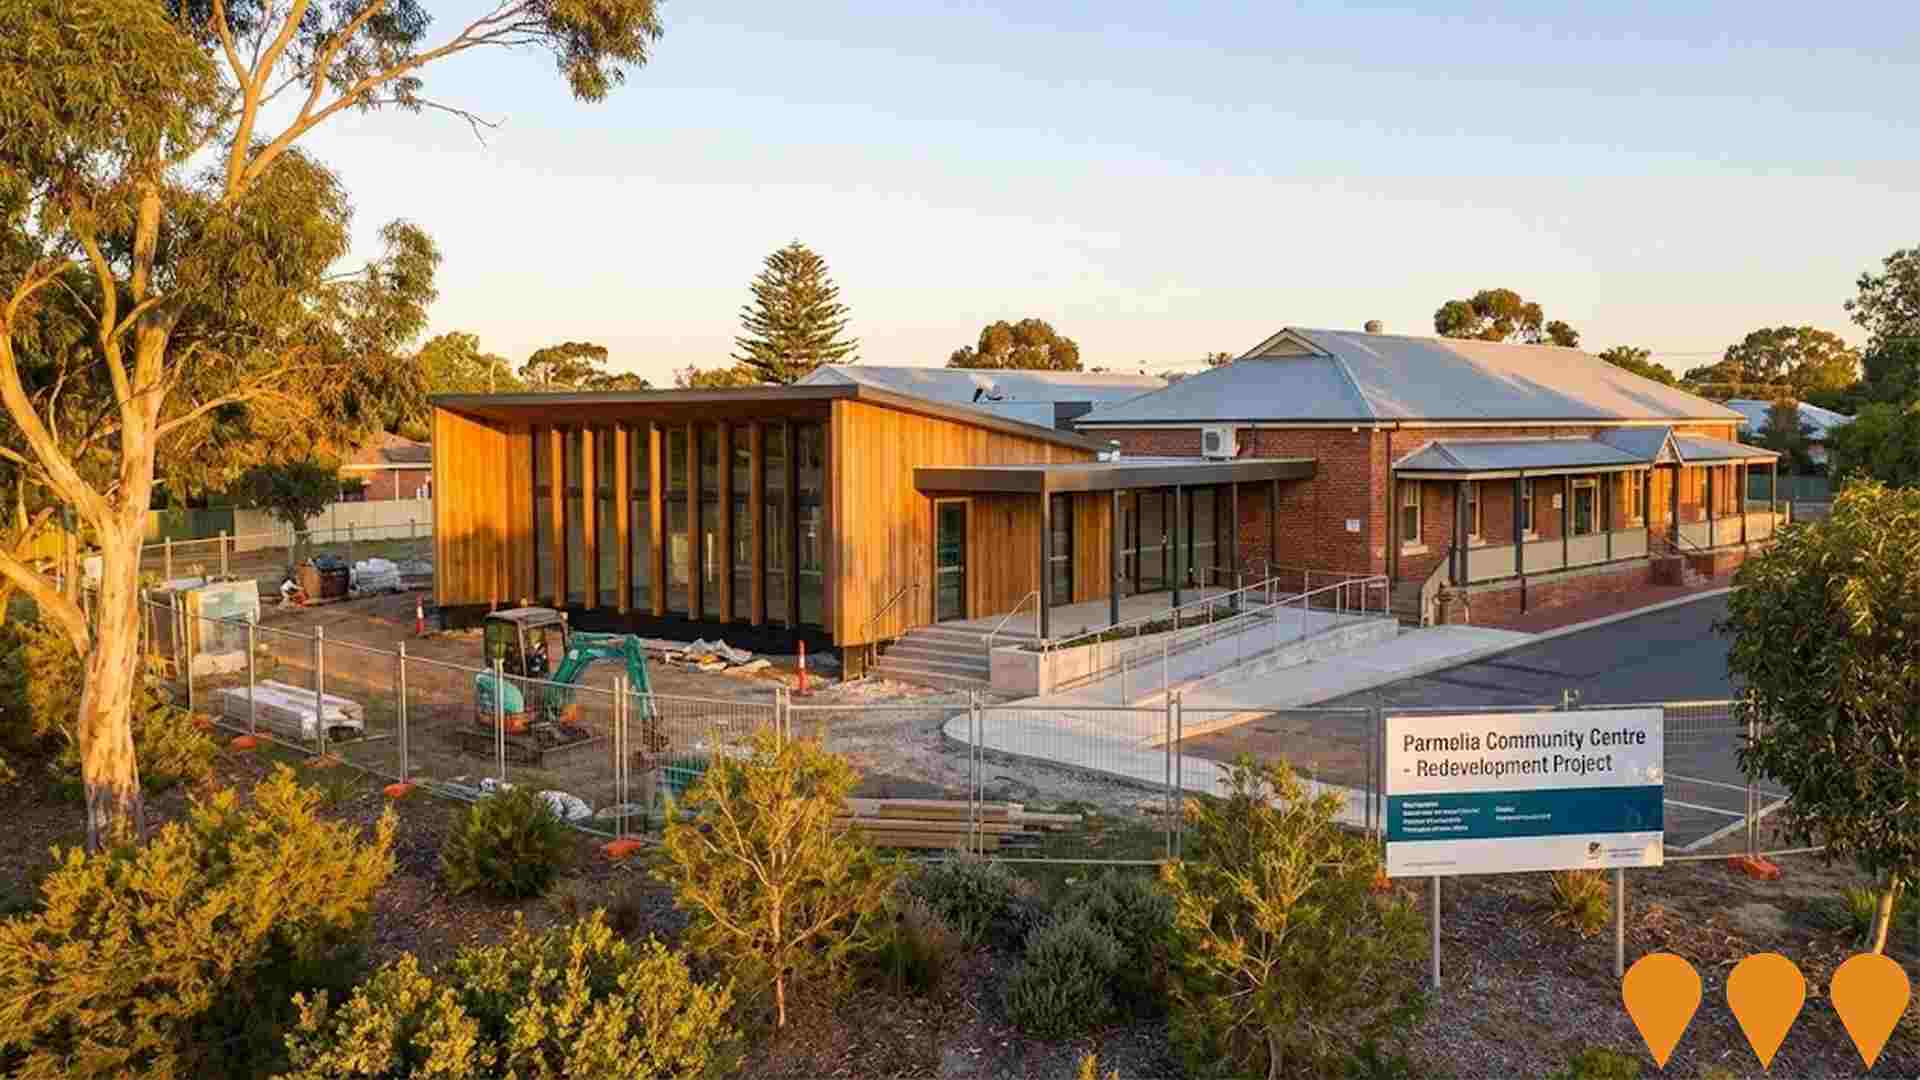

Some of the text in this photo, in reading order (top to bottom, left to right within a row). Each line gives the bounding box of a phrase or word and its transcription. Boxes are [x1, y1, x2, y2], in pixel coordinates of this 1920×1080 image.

[1403, 728, 1647, 752] Parmelia Community Centre
[1416, 757, 1549, 778] Redevelopment
[1553, 754, 1614, 776] Project
